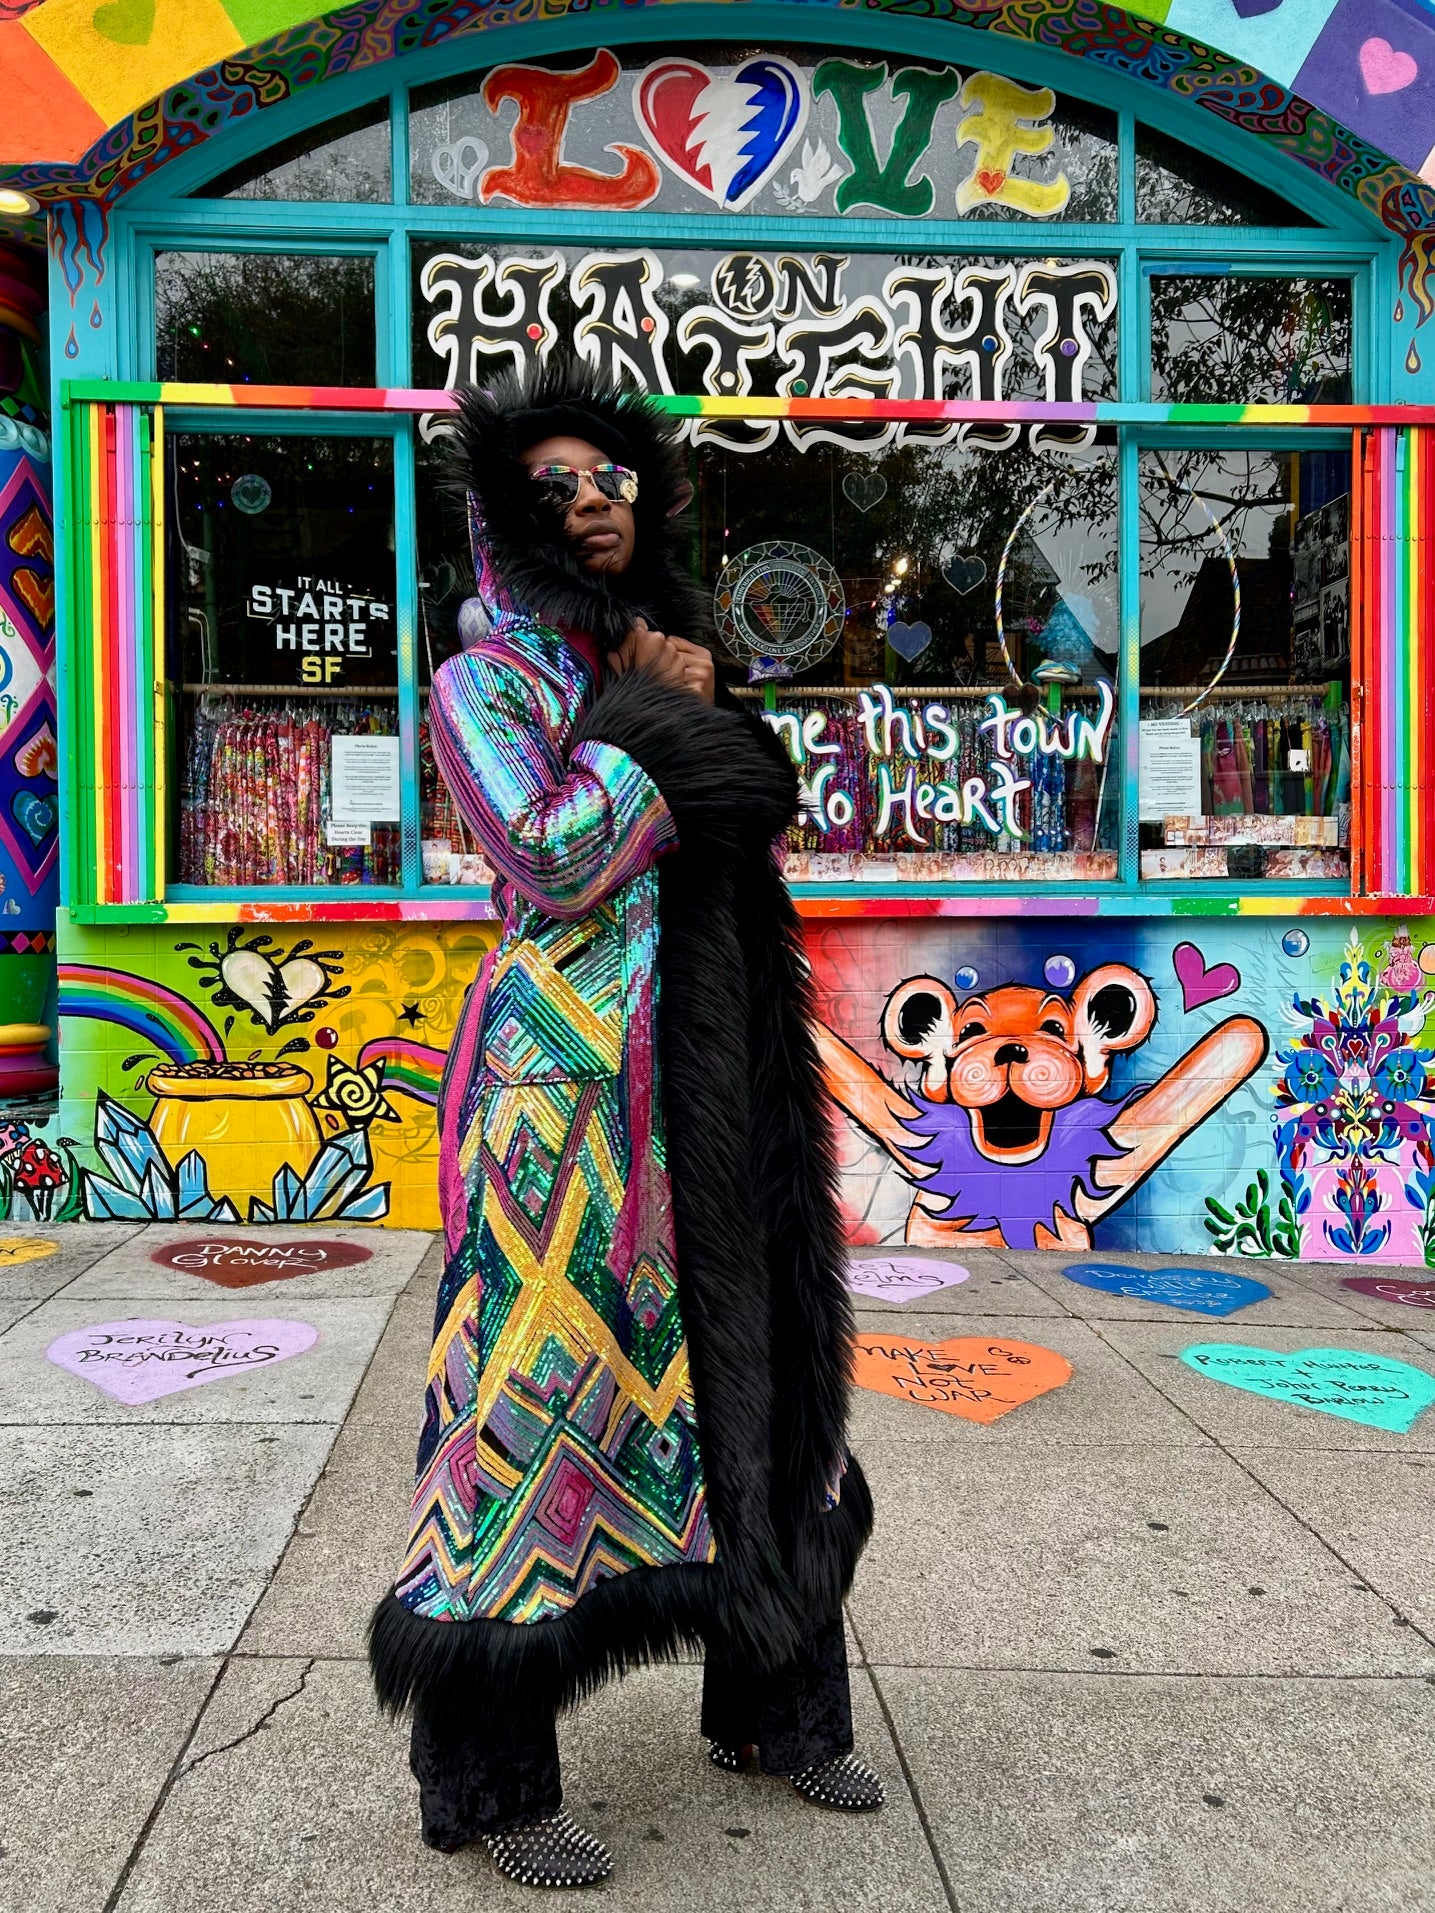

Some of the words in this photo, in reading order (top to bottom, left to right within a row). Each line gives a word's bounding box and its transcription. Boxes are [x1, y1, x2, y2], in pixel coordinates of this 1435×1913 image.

[479, 47, 1070, 217] LOVE
[710, 251, 850, 319] ON
[420, 249, 1116, 455] HAIGHT
[297, 576, 312, 589] IT
[316, 579, 344, 595] ALL
[252, 584, 389, 620] STARTS
[276, 623, 368, 651] HERE
[302, 656, 342, 683] SF
[857, 682, 961, 762] this
[851, 1271, 944, 1288] elms
[909, 1388, 1016, 1403] WAR
